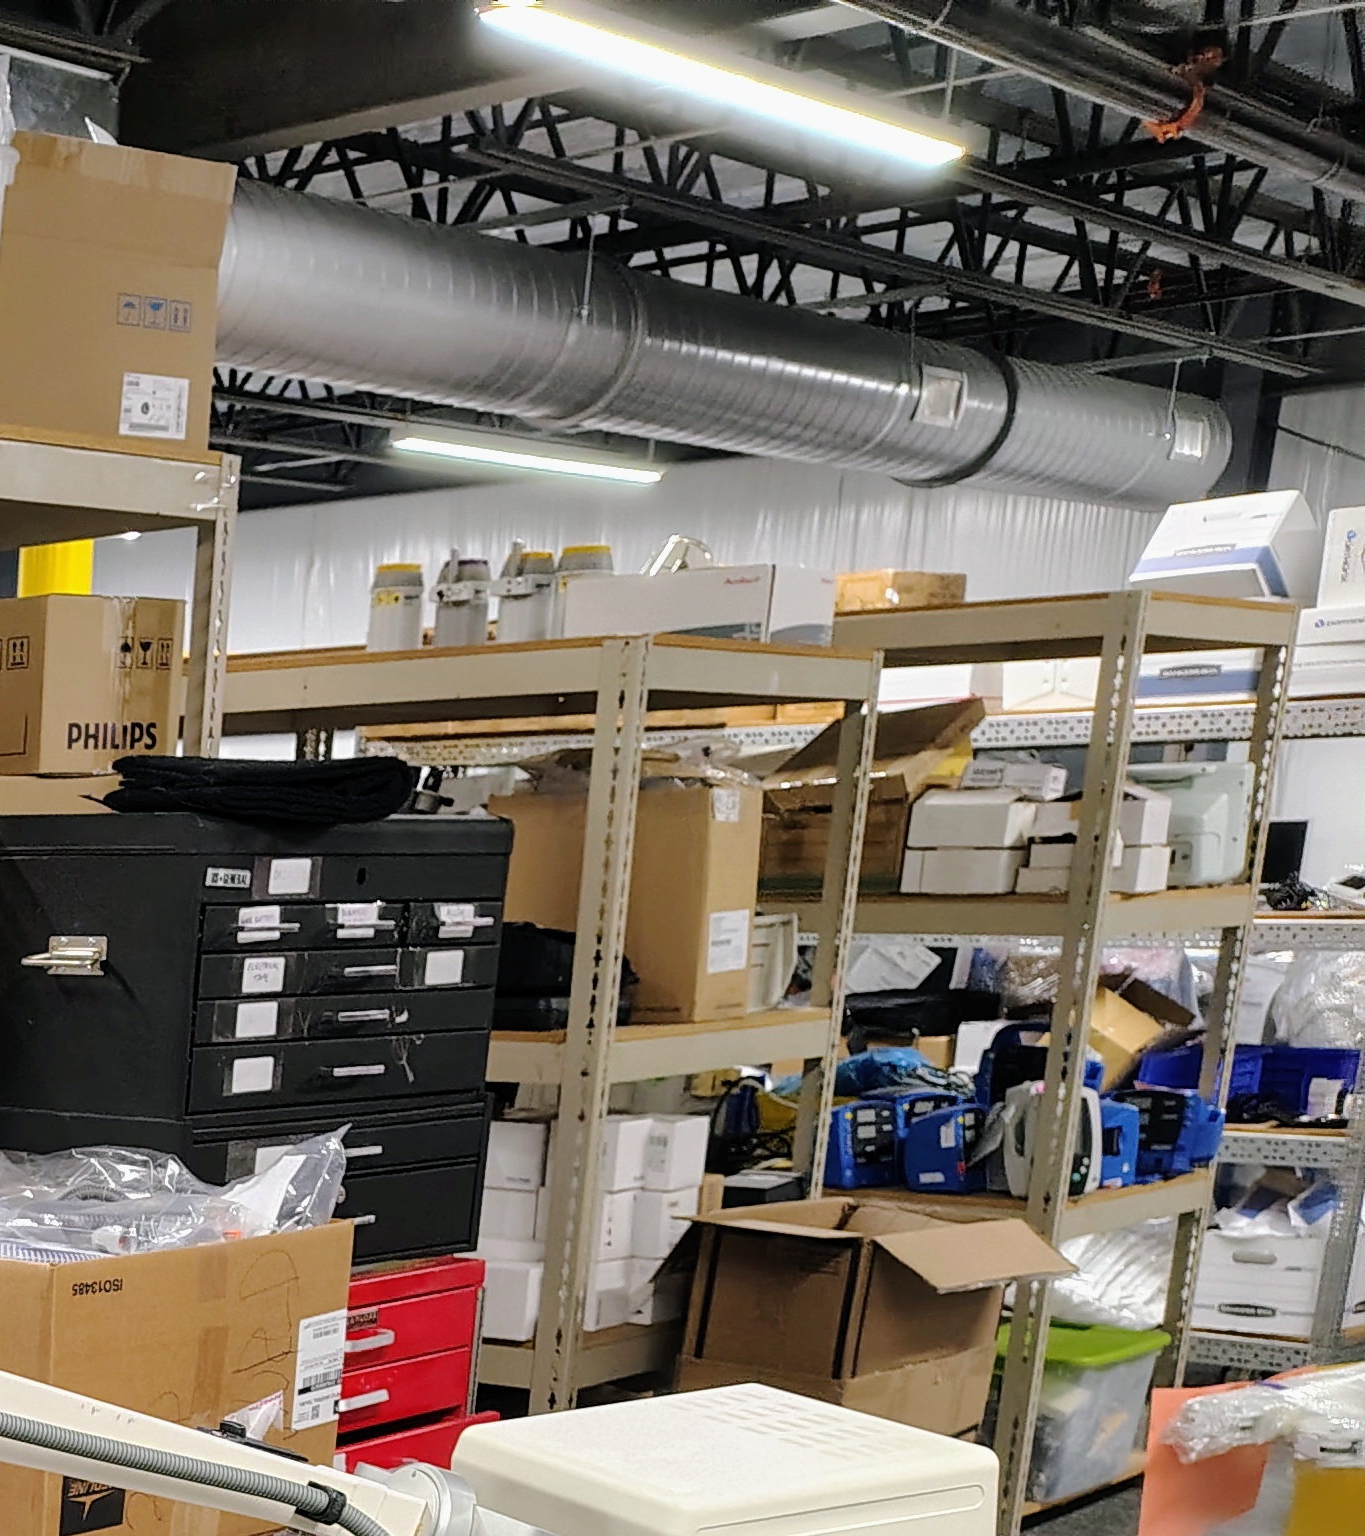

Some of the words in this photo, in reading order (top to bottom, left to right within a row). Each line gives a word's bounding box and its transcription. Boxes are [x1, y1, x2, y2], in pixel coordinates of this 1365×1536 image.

[67, 722, 157, 750] PHILIPS
[72, 1278, 124, 1296] ISO13485
[68, 1478, 116, 1497] EDLINE
